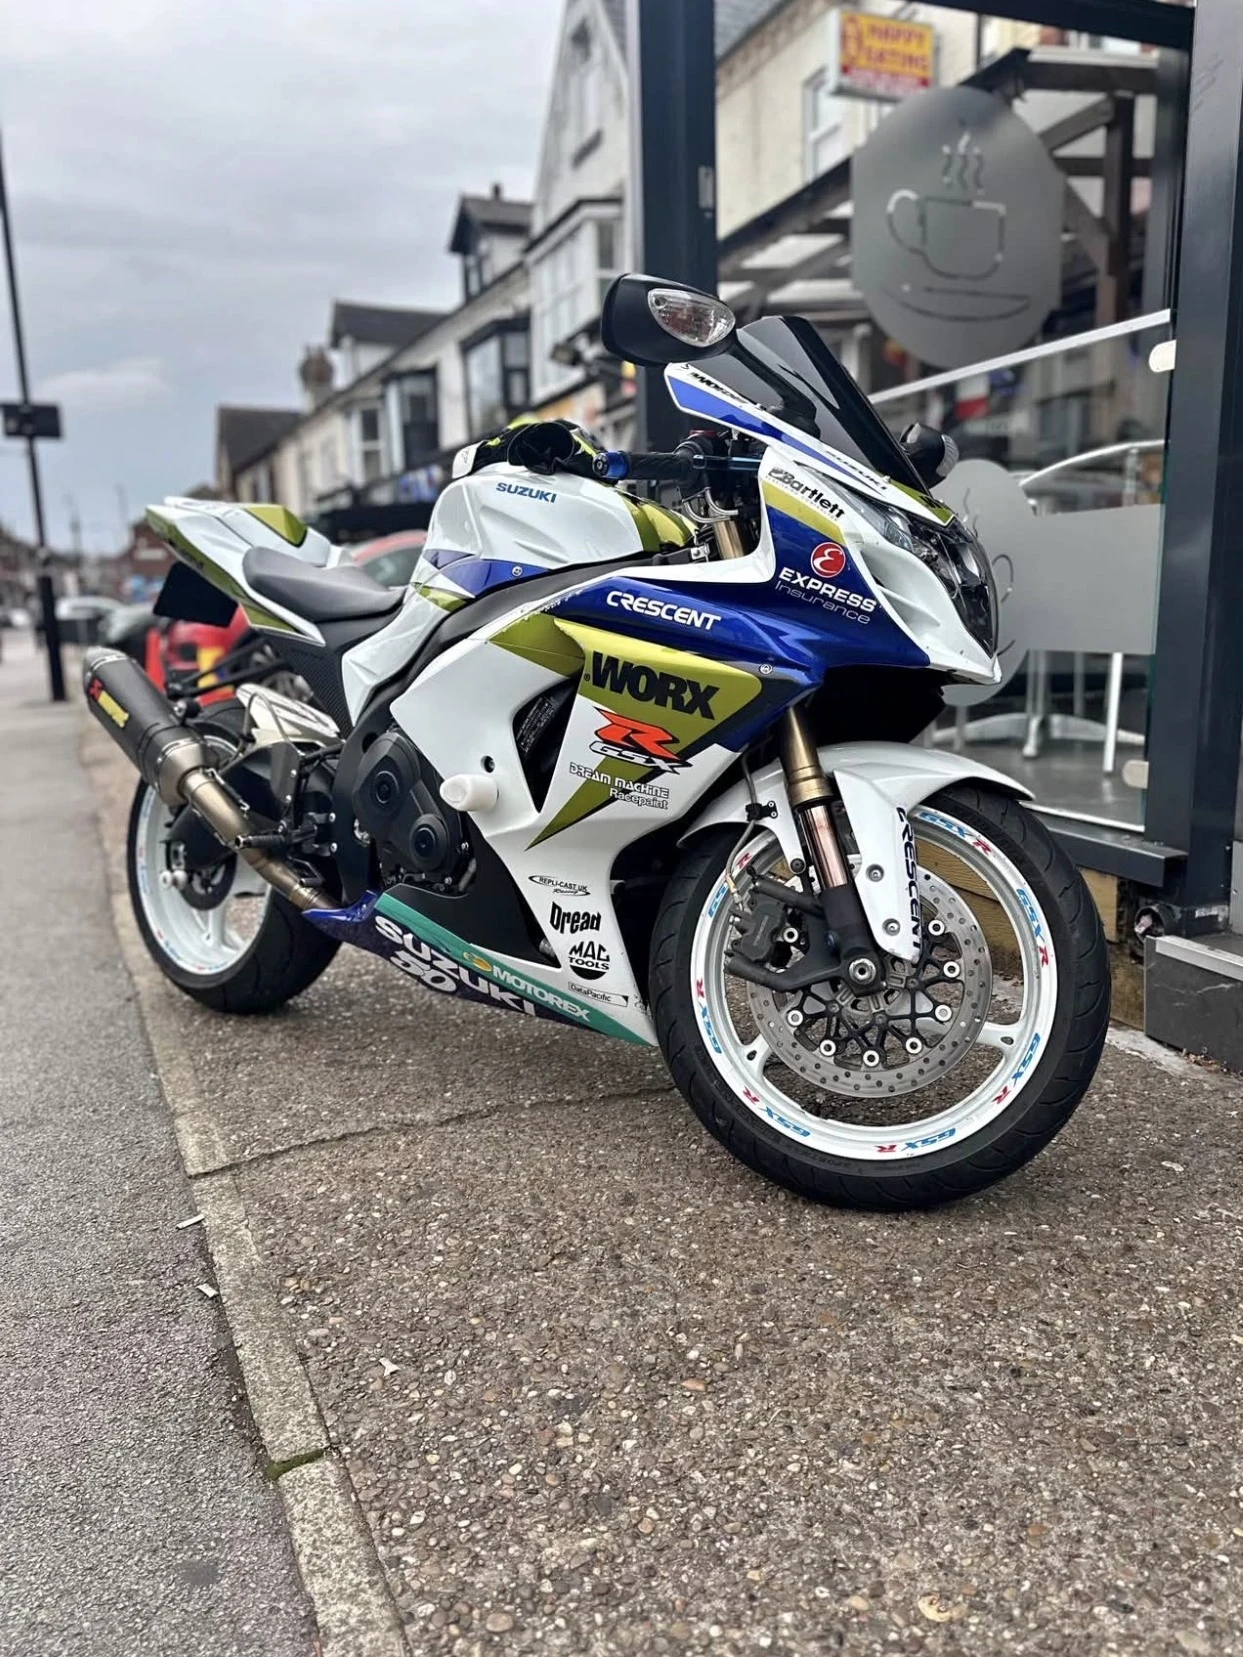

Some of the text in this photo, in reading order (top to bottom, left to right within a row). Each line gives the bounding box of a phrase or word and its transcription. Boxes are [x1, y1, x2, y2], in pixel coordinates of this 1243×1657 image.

[867, 46, 929, 72] EATING
[496, 482, 557, 503] SUZUKI
[779, 469, 845, 519] Bartlett
[775, 580, 871, 625] Insurance
[778, 566, 877, 613] EXPRESS
[606, 591, 722, 630] CRESCENT
[592, 650, 720, 721] WORX
[569, 762, 612, 785] DREAM
[589, 740, 693, 775] GSX
[609, 788, 669, 810] Racepaint
[577, 885, 588, 893] UK
[549, 901, 602, 934] Dread
[375, 915, 536, 1017] SUZUKI
[568, 941, 611, 962] MAC
[568, 956, 610, 971] TOOLS
[493, 965, 590, 1022] MOTOREX
[569, 983, 612, 1002] DataPacific
